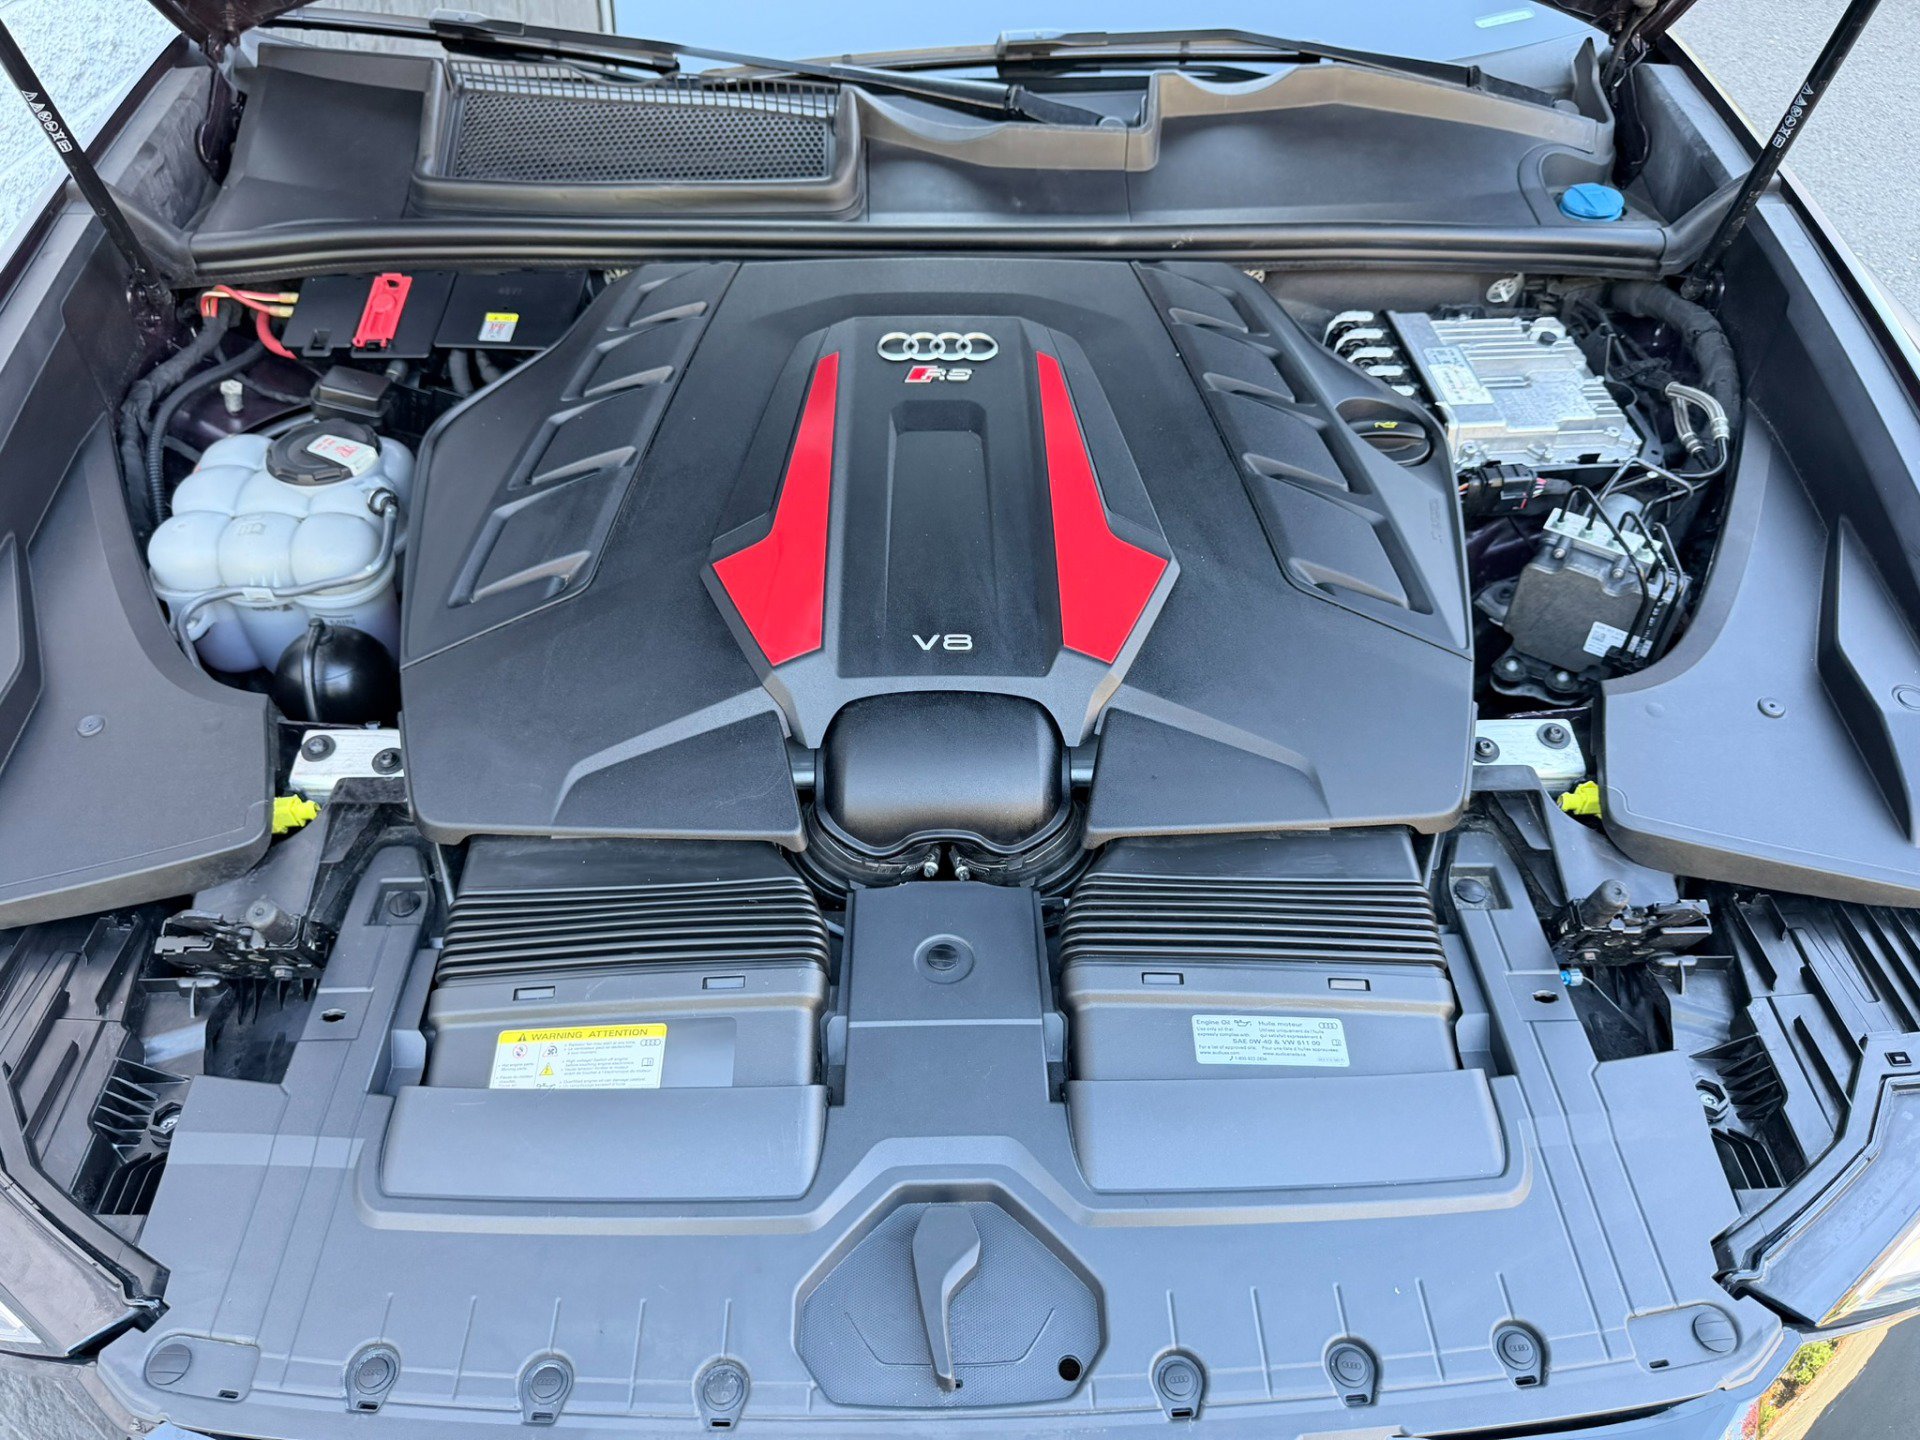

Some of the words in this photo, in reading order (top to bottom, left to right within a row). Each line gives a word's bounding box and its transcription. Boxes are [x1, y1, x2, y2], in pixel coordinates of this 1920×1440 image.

[908, 365, 973, 382] RS
[912, 634, 973, 650] V8
[532, 1031, 583, 1040] WARNING
[588, 1028, 648, 1038] ATTENTION
